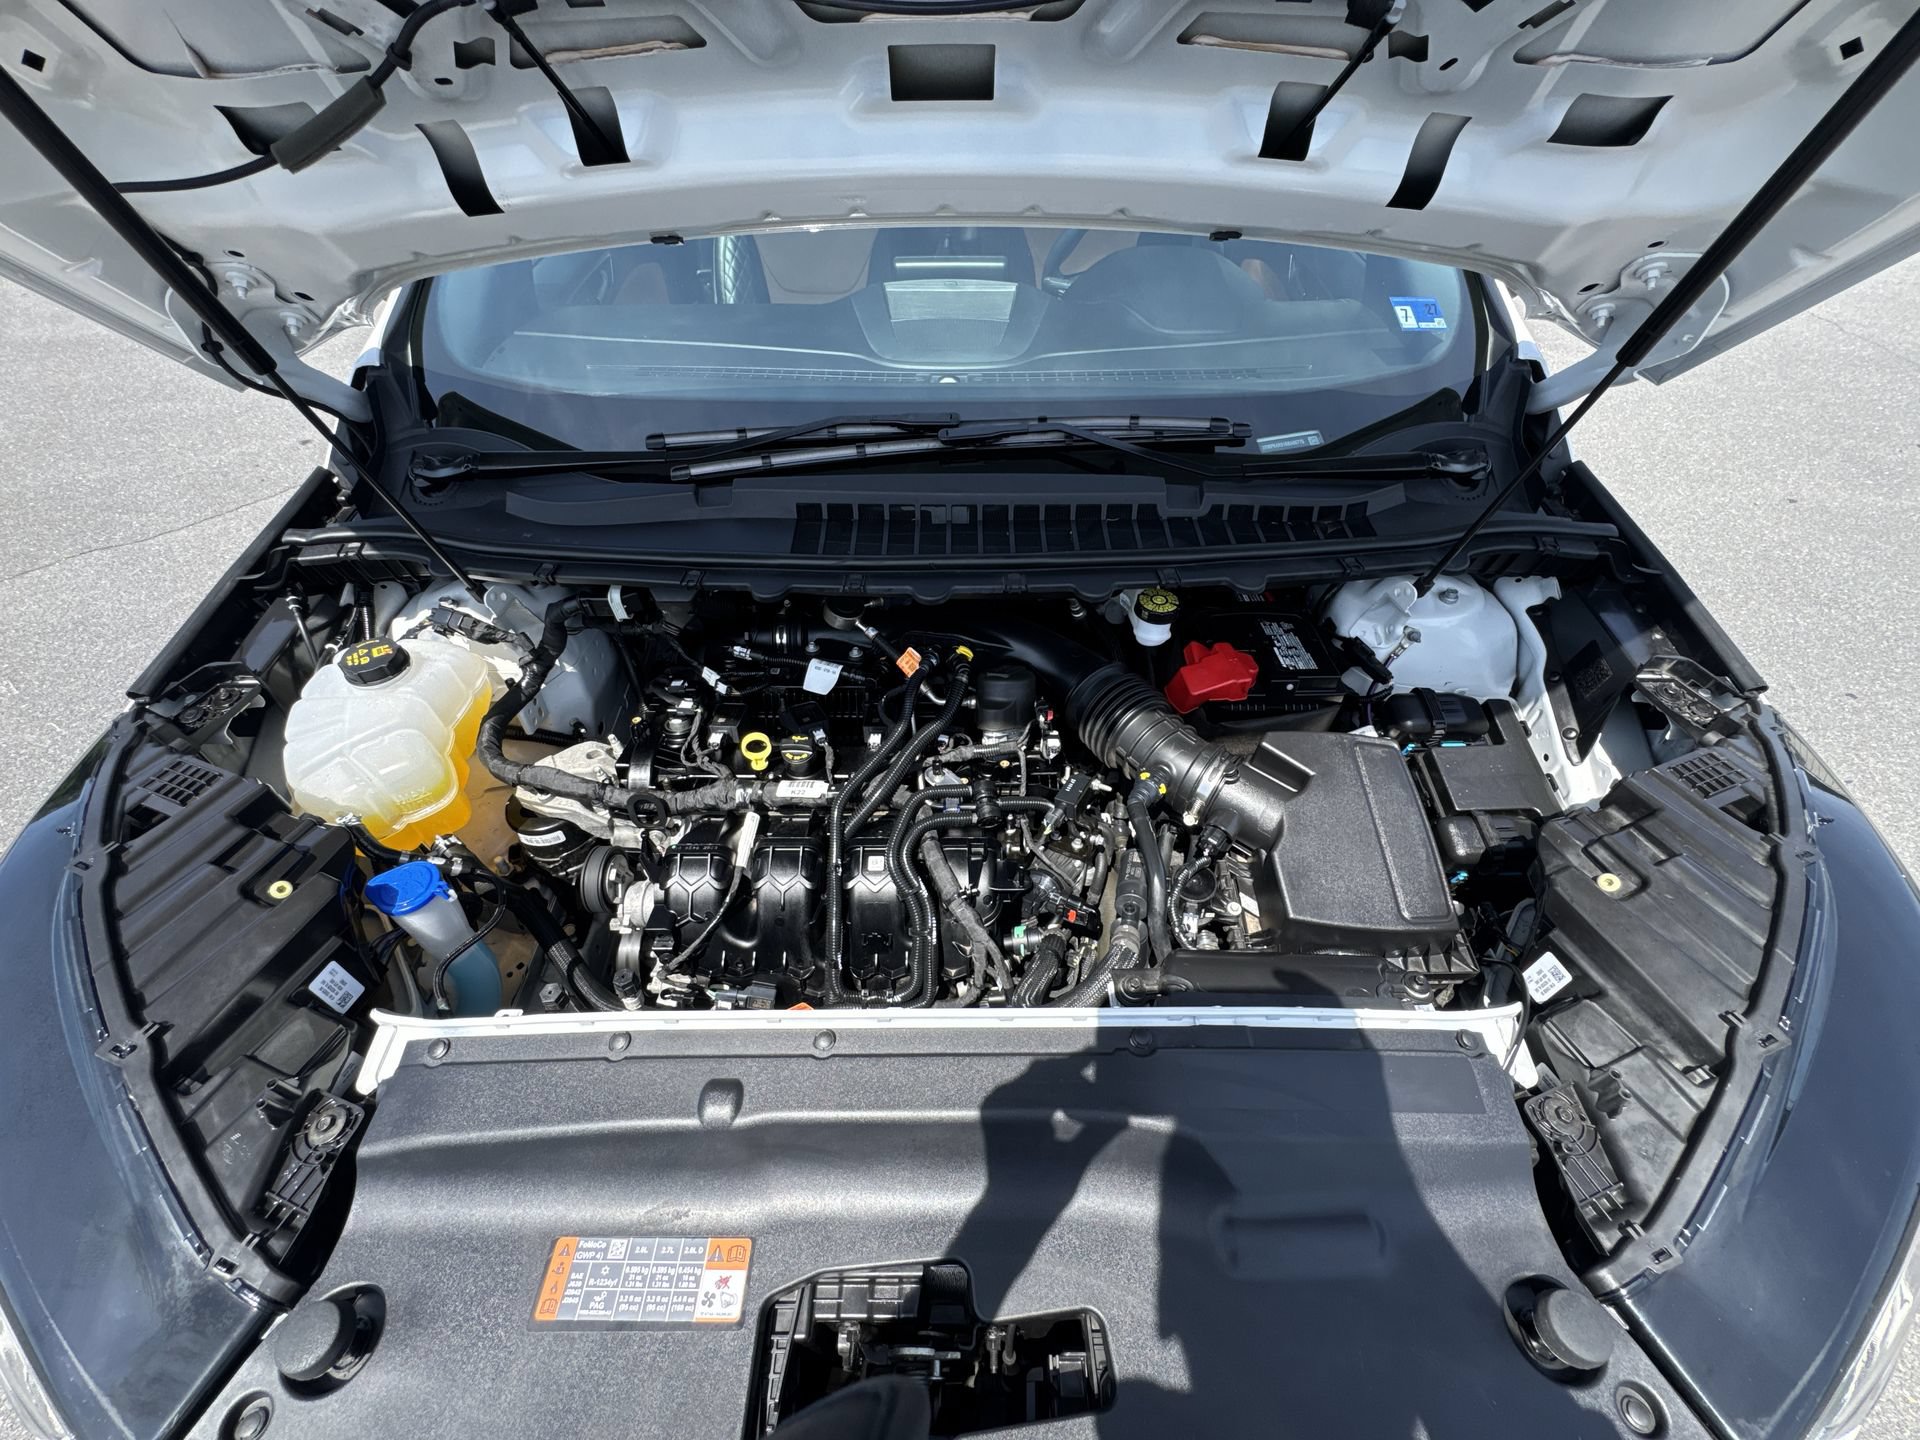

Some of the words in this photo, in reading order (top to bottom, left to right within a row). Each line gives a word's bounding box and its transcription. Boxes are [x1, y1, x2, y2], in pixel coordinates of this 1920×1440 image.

[1400, 308, 1408, 323] 7
[578, 1240, 607, 1249] FoMoCo
[574, 1250, 595, 1261] (GWP
[595, 1251, 604, 1261] 4)
[641, 1266, 649, 1276] kg
[668, 1266, 676, 1276] kg
[694, 1266, 702, 1276] kg
[588, 1278, 618, 1288] R-1234yf
[589, 1301, 605, 1310] PAG
